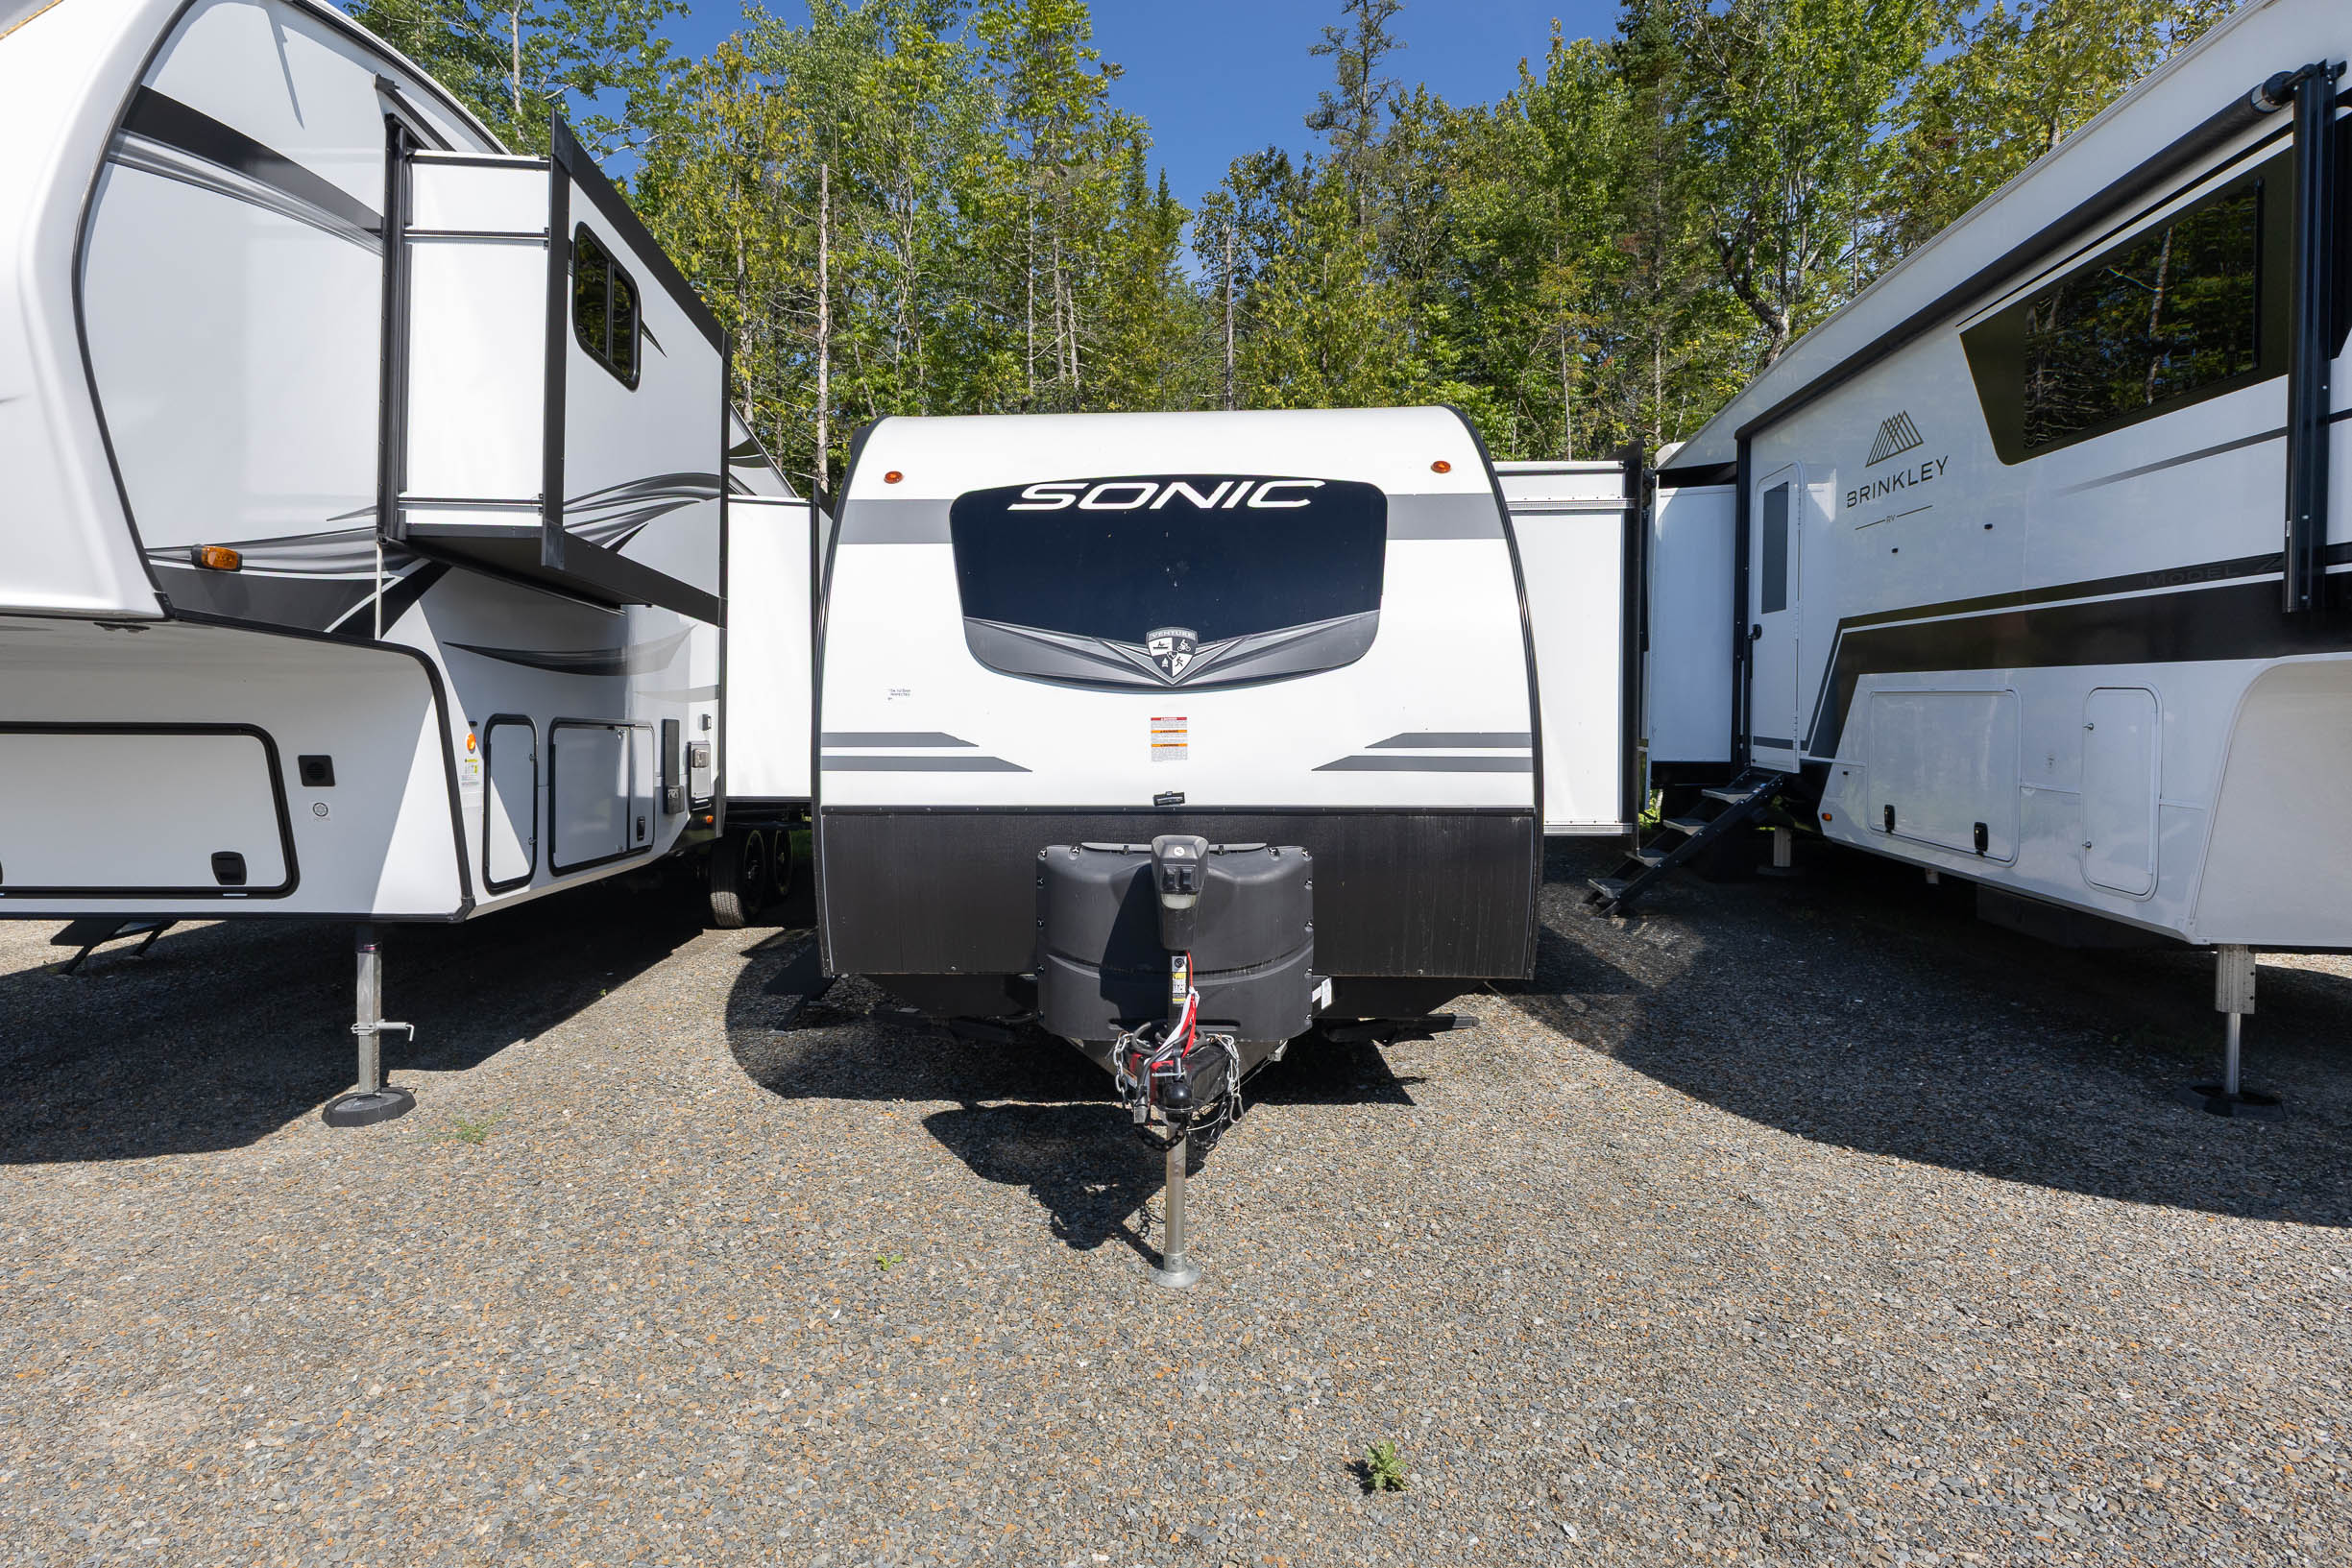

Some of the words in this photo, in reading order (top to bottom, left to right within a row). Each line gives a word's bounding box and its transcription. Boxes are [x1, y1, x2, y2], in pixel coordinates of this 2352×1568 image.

[1846, 455, 1949, 509] BRINKLEY
[1007, 480, 1325, 510] SONIC
[1885, 515, 1897, 523] RV
[2146, 566, 2239, 585] MODEL
[1151, 630, 1196, 640] VENTURE
